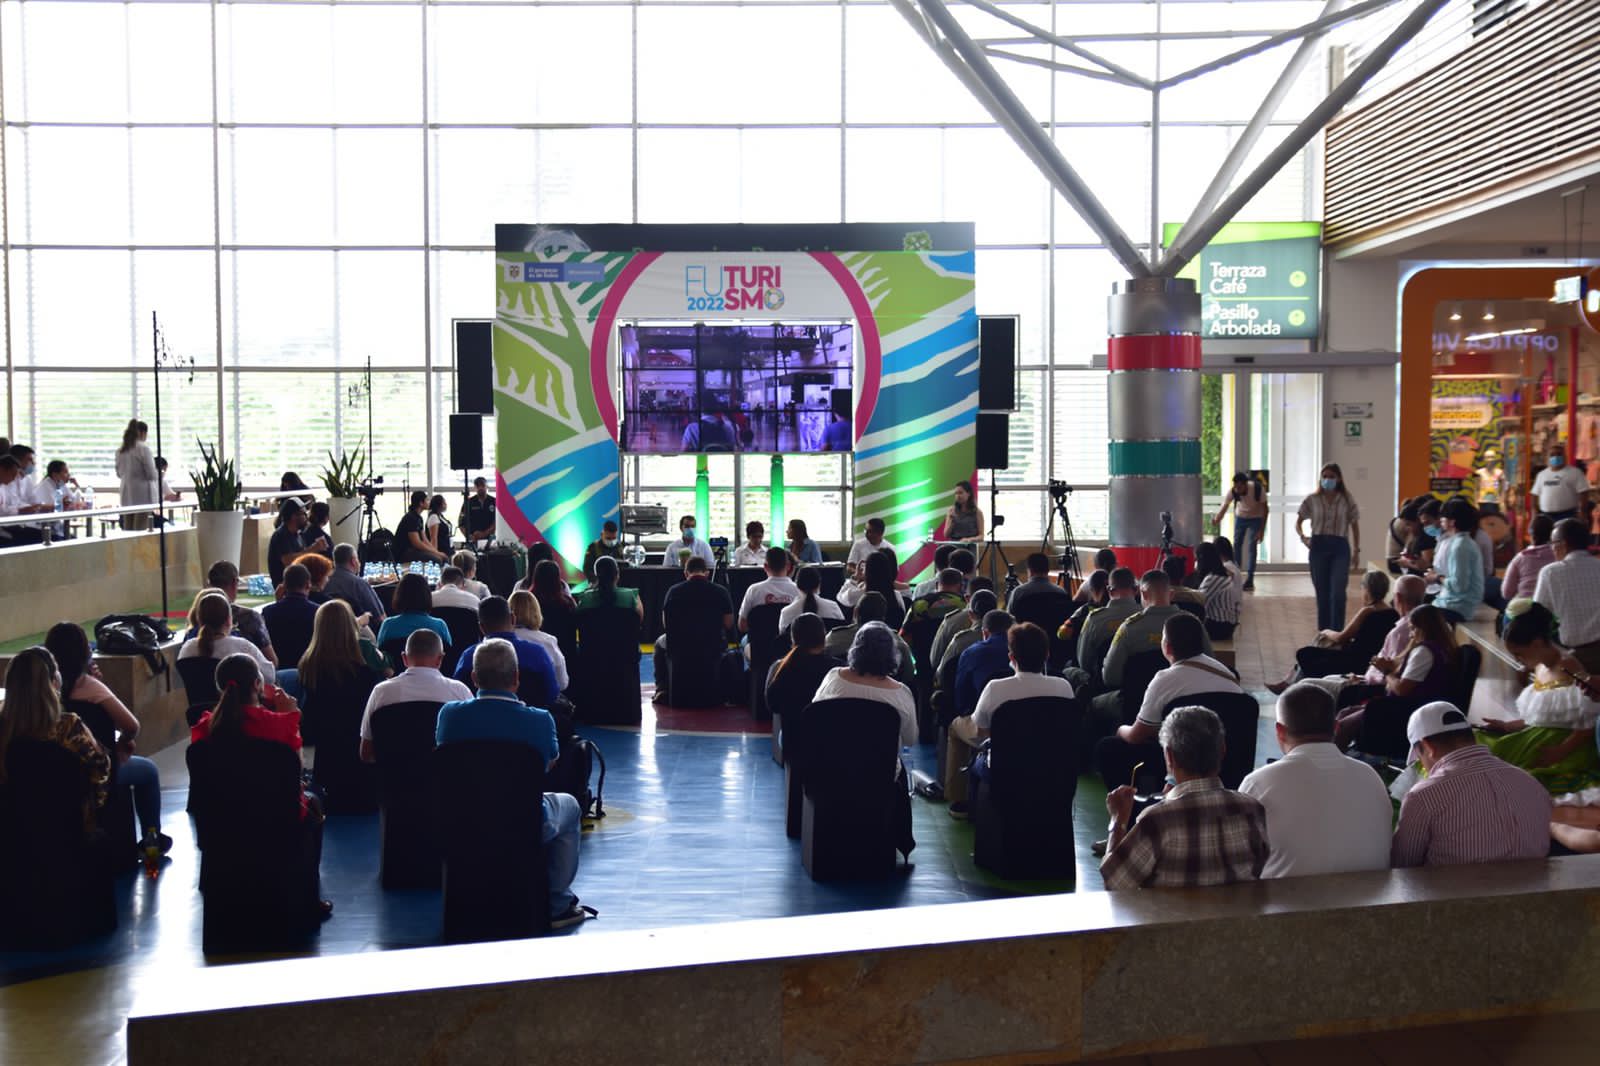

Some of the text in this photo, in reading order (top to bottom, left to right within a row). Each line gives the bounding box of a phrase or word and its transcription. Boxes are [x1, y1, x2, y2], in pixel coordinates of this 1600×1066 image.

[1209, 262, 1266, 277] Terraza
[1209, 278, 1247, 294] Café
[687, 297, 724, 311] 2022
[1210, 302, 1259, 319] Pasillo
[1209, 319, 1281, 335] Arbolada
